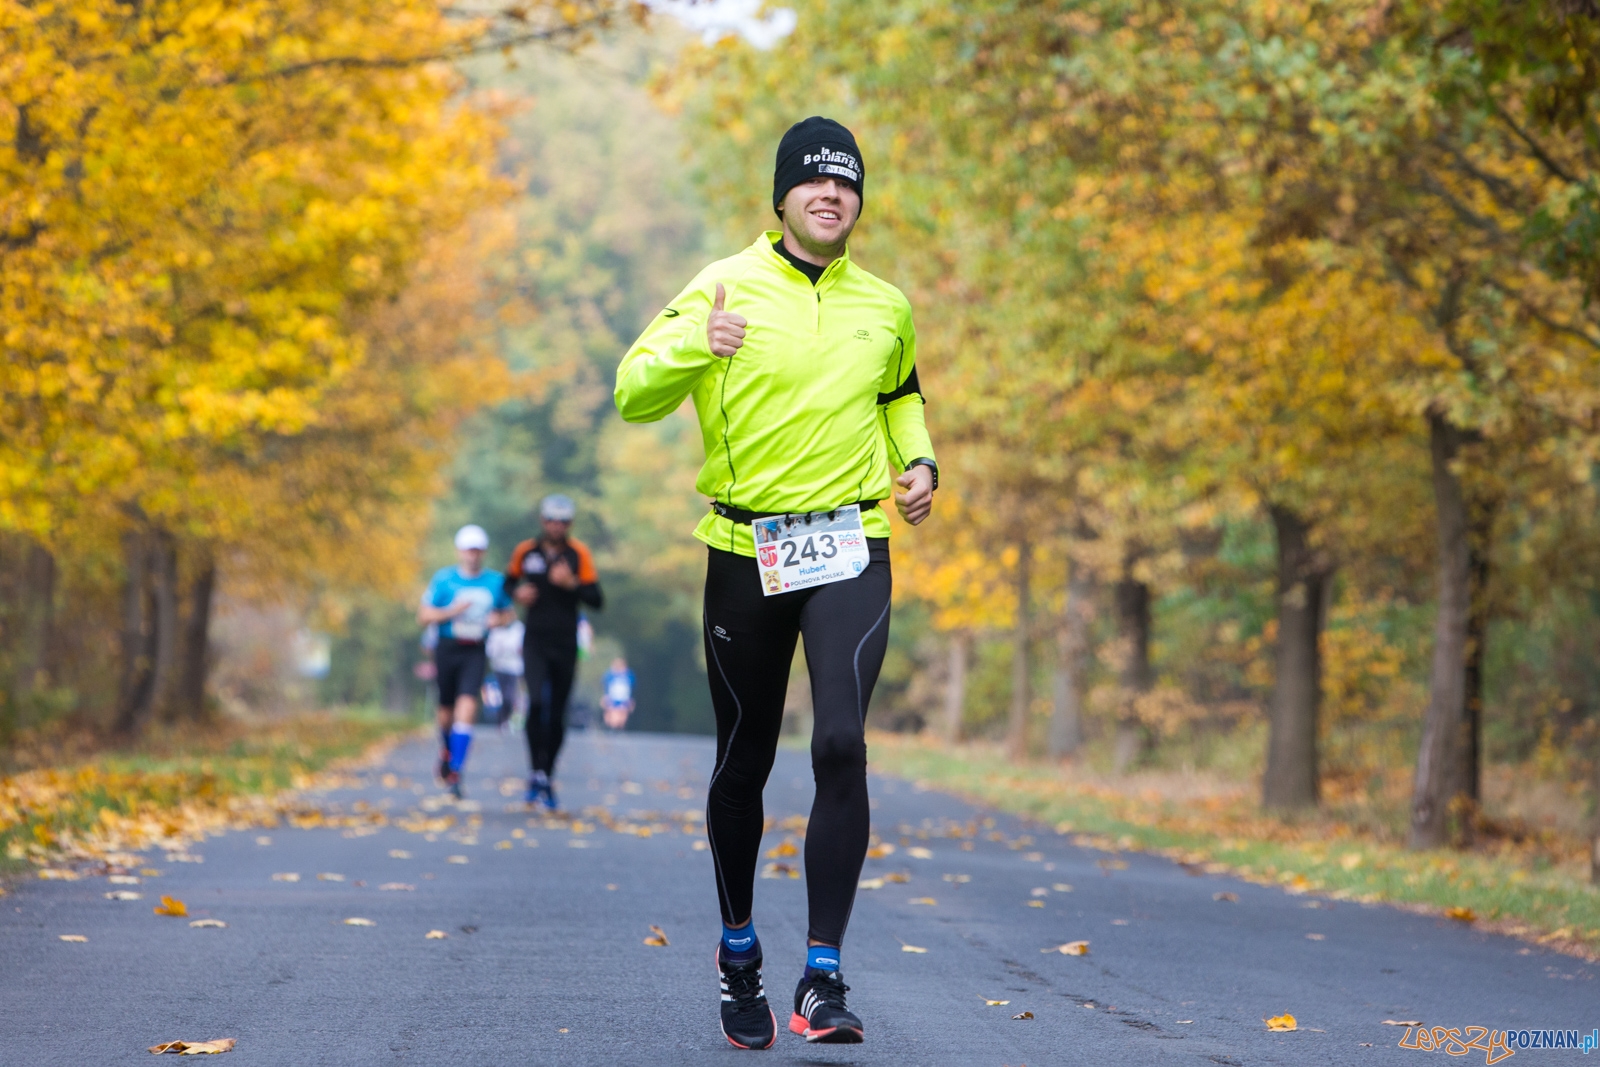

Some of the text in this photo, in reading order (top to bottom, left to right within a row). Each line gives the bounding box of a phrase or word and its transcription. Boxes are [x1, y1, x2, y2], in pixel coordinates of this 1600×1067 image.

[780, 534, 838, 568] 243
[799, 564, 826, 575] Hubert
[790, 571, 845, 587] POLINOVA POLSKA
